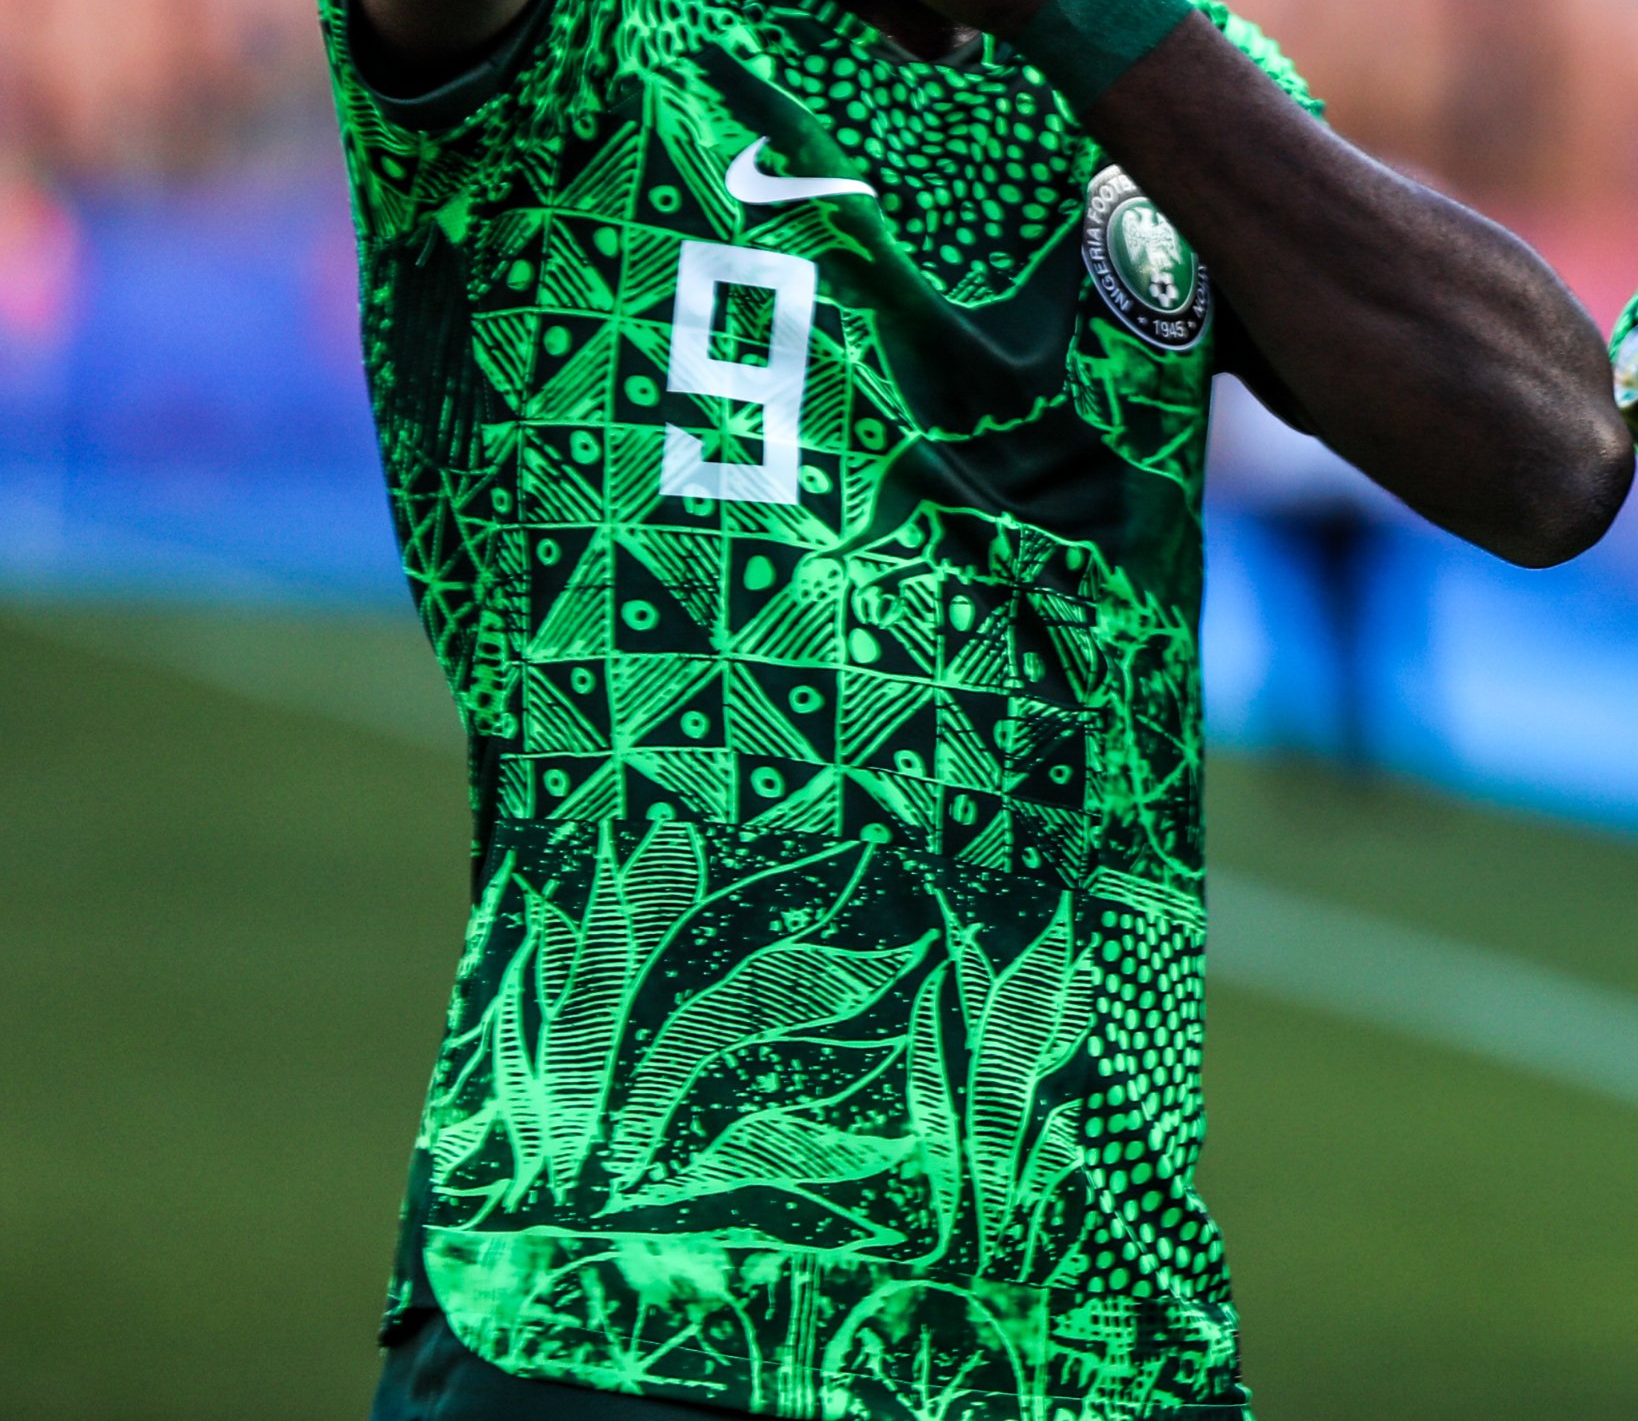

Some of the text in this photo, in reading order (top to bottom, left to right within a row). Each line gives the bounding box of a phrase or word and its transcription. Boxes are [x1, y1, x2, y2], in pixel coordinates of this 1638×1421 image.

[1086, 174, 1137, 311] NIGERIA FOOTB
[660, 240, 819, 505] 9
[1152, 319, 1187, 338] 1945
